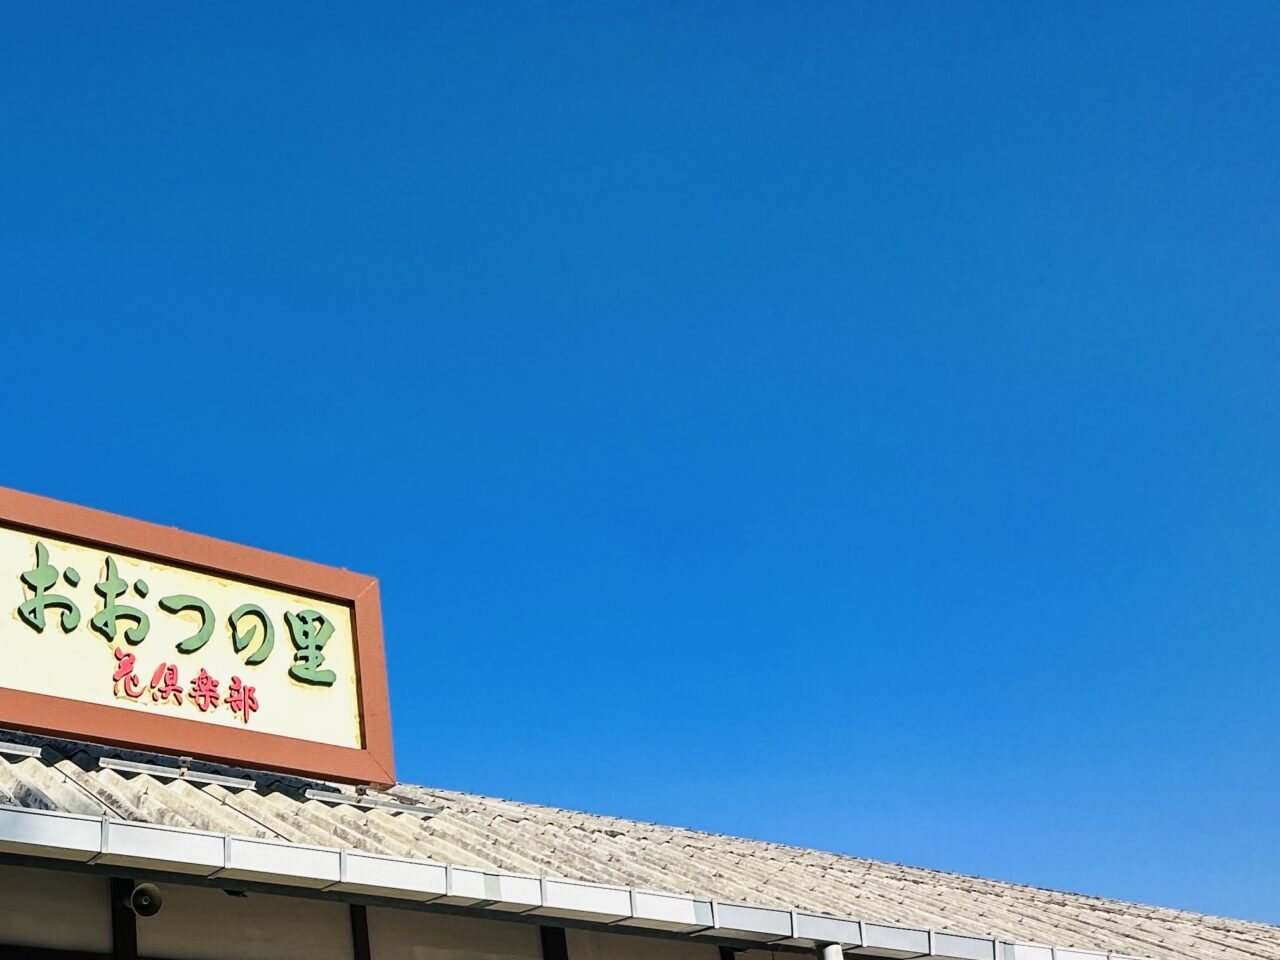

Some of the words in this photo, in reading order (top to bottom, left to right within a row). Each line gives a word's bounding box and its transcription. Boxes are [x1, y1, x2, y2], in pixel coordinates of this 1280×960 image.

[17, 541, 337, 688] おおつの里
[112, 648, 260, 724] 花倶楽部
